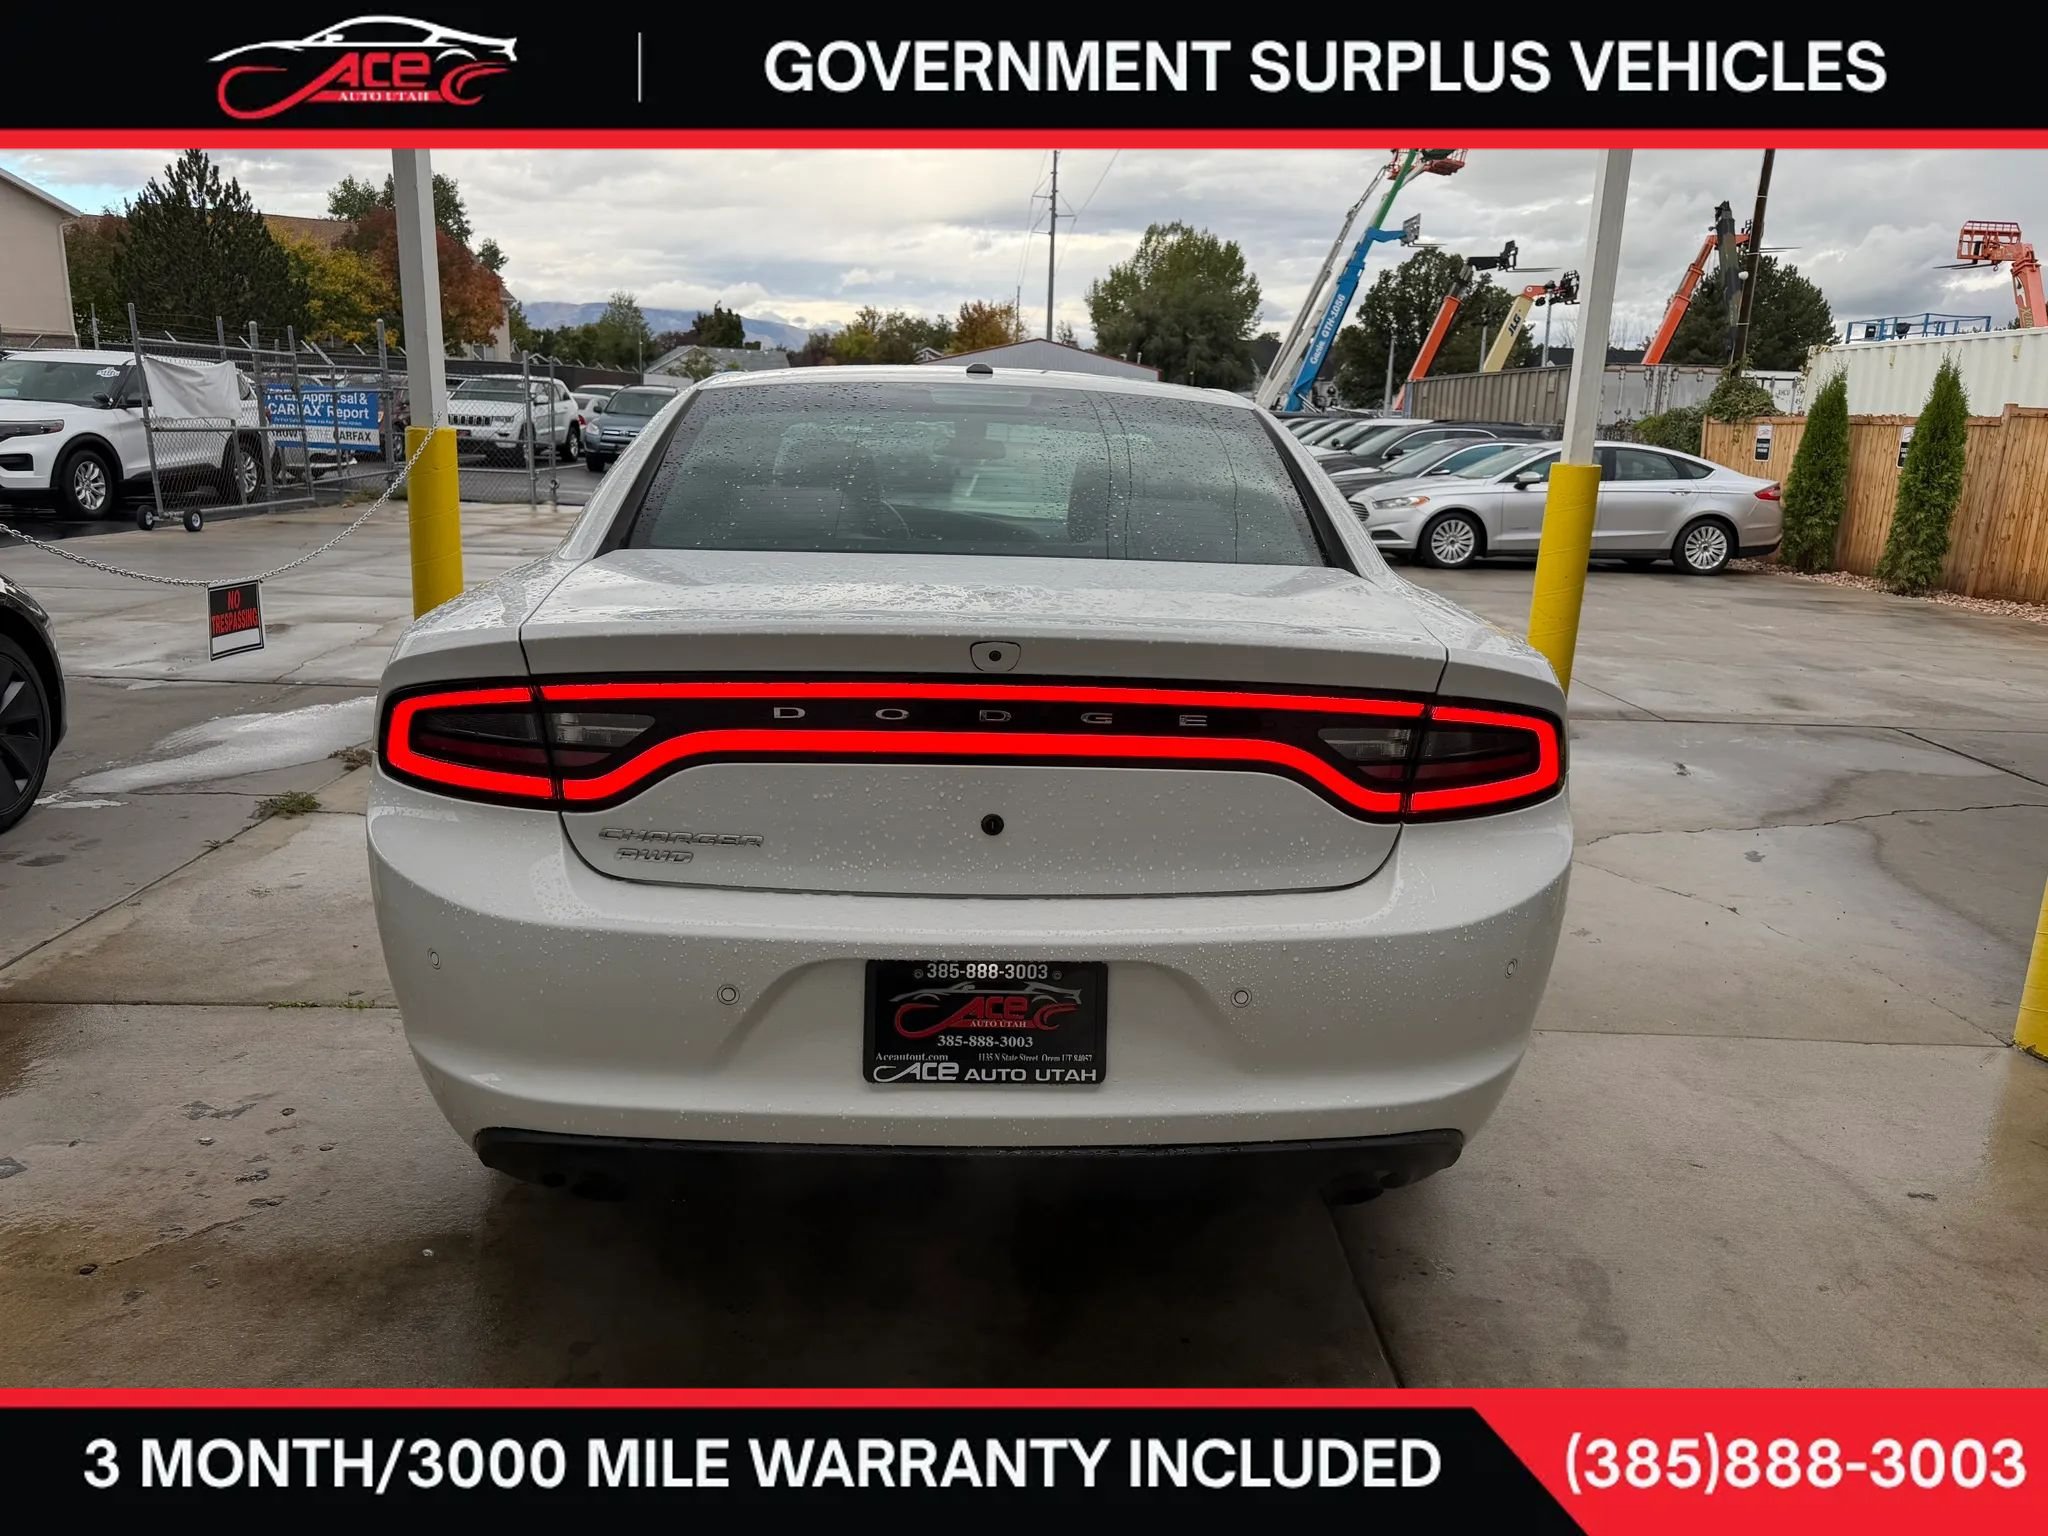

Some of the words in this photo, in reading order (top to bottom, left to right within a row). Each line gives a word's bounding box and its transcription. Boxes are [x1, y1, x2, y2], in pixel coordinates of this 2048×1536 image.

[1508, 313, 1521, 337] JLG
[227, 590, 241, 610] NO
[211, 607, 259, 635] TRESPASSING
[773, 706, 1208, 727] DODGE
[599, 828, 764, 847] CHARGER
[615, 847, 694, 864] AWD
[927, 963, 1048, 980] 385-888-3003
[970, 1020, 998, 1028] AUTO
[999, 1020, 1027, 1028] UTAH
[937, 1035, 1033, 1048] 385-888-3003
[1001, 1052, 1019, 1062] State
[1019, 1053, 1039, 1062] Street
[964, 1068, 1027, 1082] AUTO
[1035, 1068, 1097, 1082] UTAH
